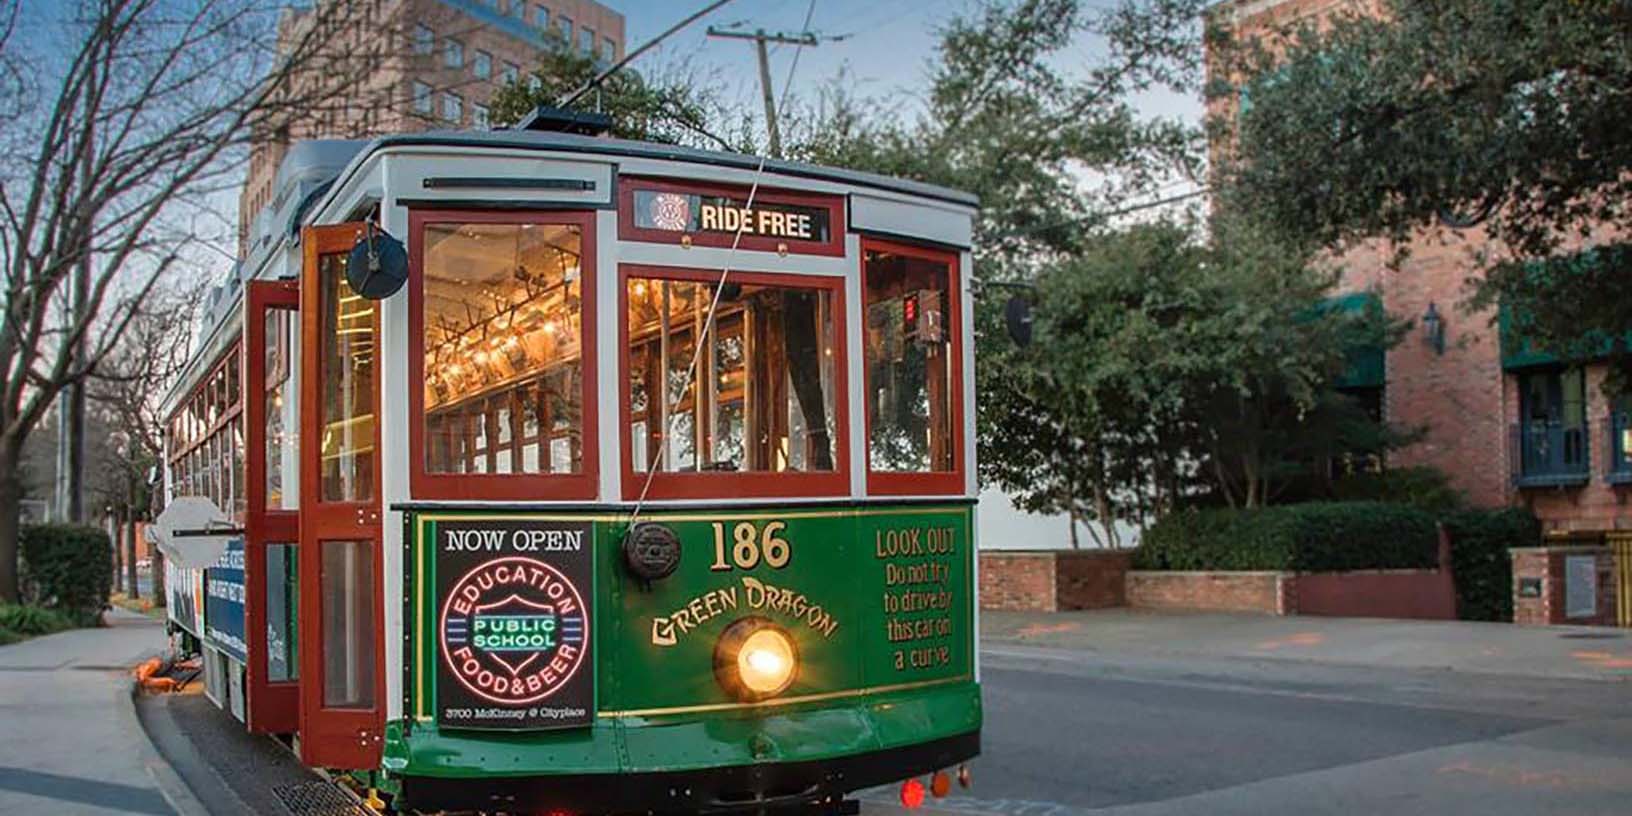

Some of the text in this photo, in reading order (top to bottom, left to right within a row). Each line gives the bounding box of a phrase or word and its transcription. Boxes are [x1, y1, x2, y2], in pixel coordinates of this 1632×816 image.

[702, 205, 753, 233] RIDE
[759, 212, 811, 238] FREE
[445, 530, 584, 551] NOW OPEN
[710, 521, 790, 570] 186
[876, 528, 955, 556] LOOK OUT
[886, 562, 949, 586] Do not try
[453, 566, 576, 615] EDUCATION
[884, 589, 953, 613] to drive by
[652, 576, 839, 646] GREEN DRAGON
[474, 619, 556, 632] PUBLIC
[888, 618, 952, 641] this car on
[474, 635, 556, 647] SCHOOL
[895, 646, 949, 669] a curve
[445, 706, 586, 720] 3700 McKinney @ Cityplace
